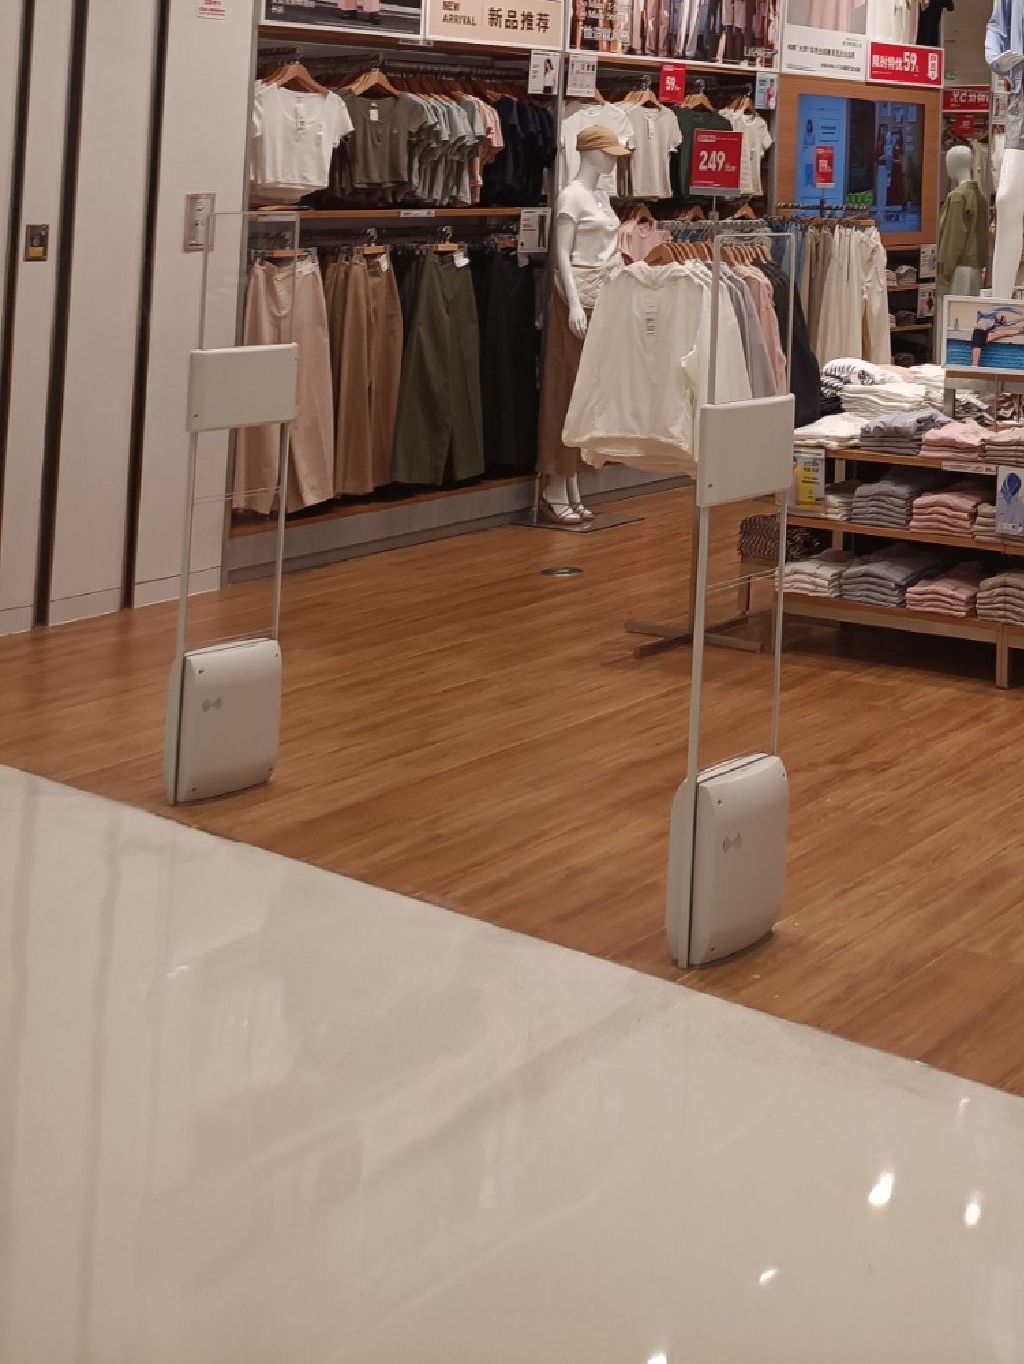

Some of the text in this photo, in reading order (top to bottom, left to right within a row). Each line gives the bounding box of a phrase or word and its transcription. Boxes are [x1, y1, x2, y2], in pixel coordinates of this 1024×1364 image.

[442, 0, 461, 12] NEW
[442, 14, 477, 27] ARRIVAL
[487, 6, 551, 34] 新品推荐
[699, 150, 726, 172] 249
